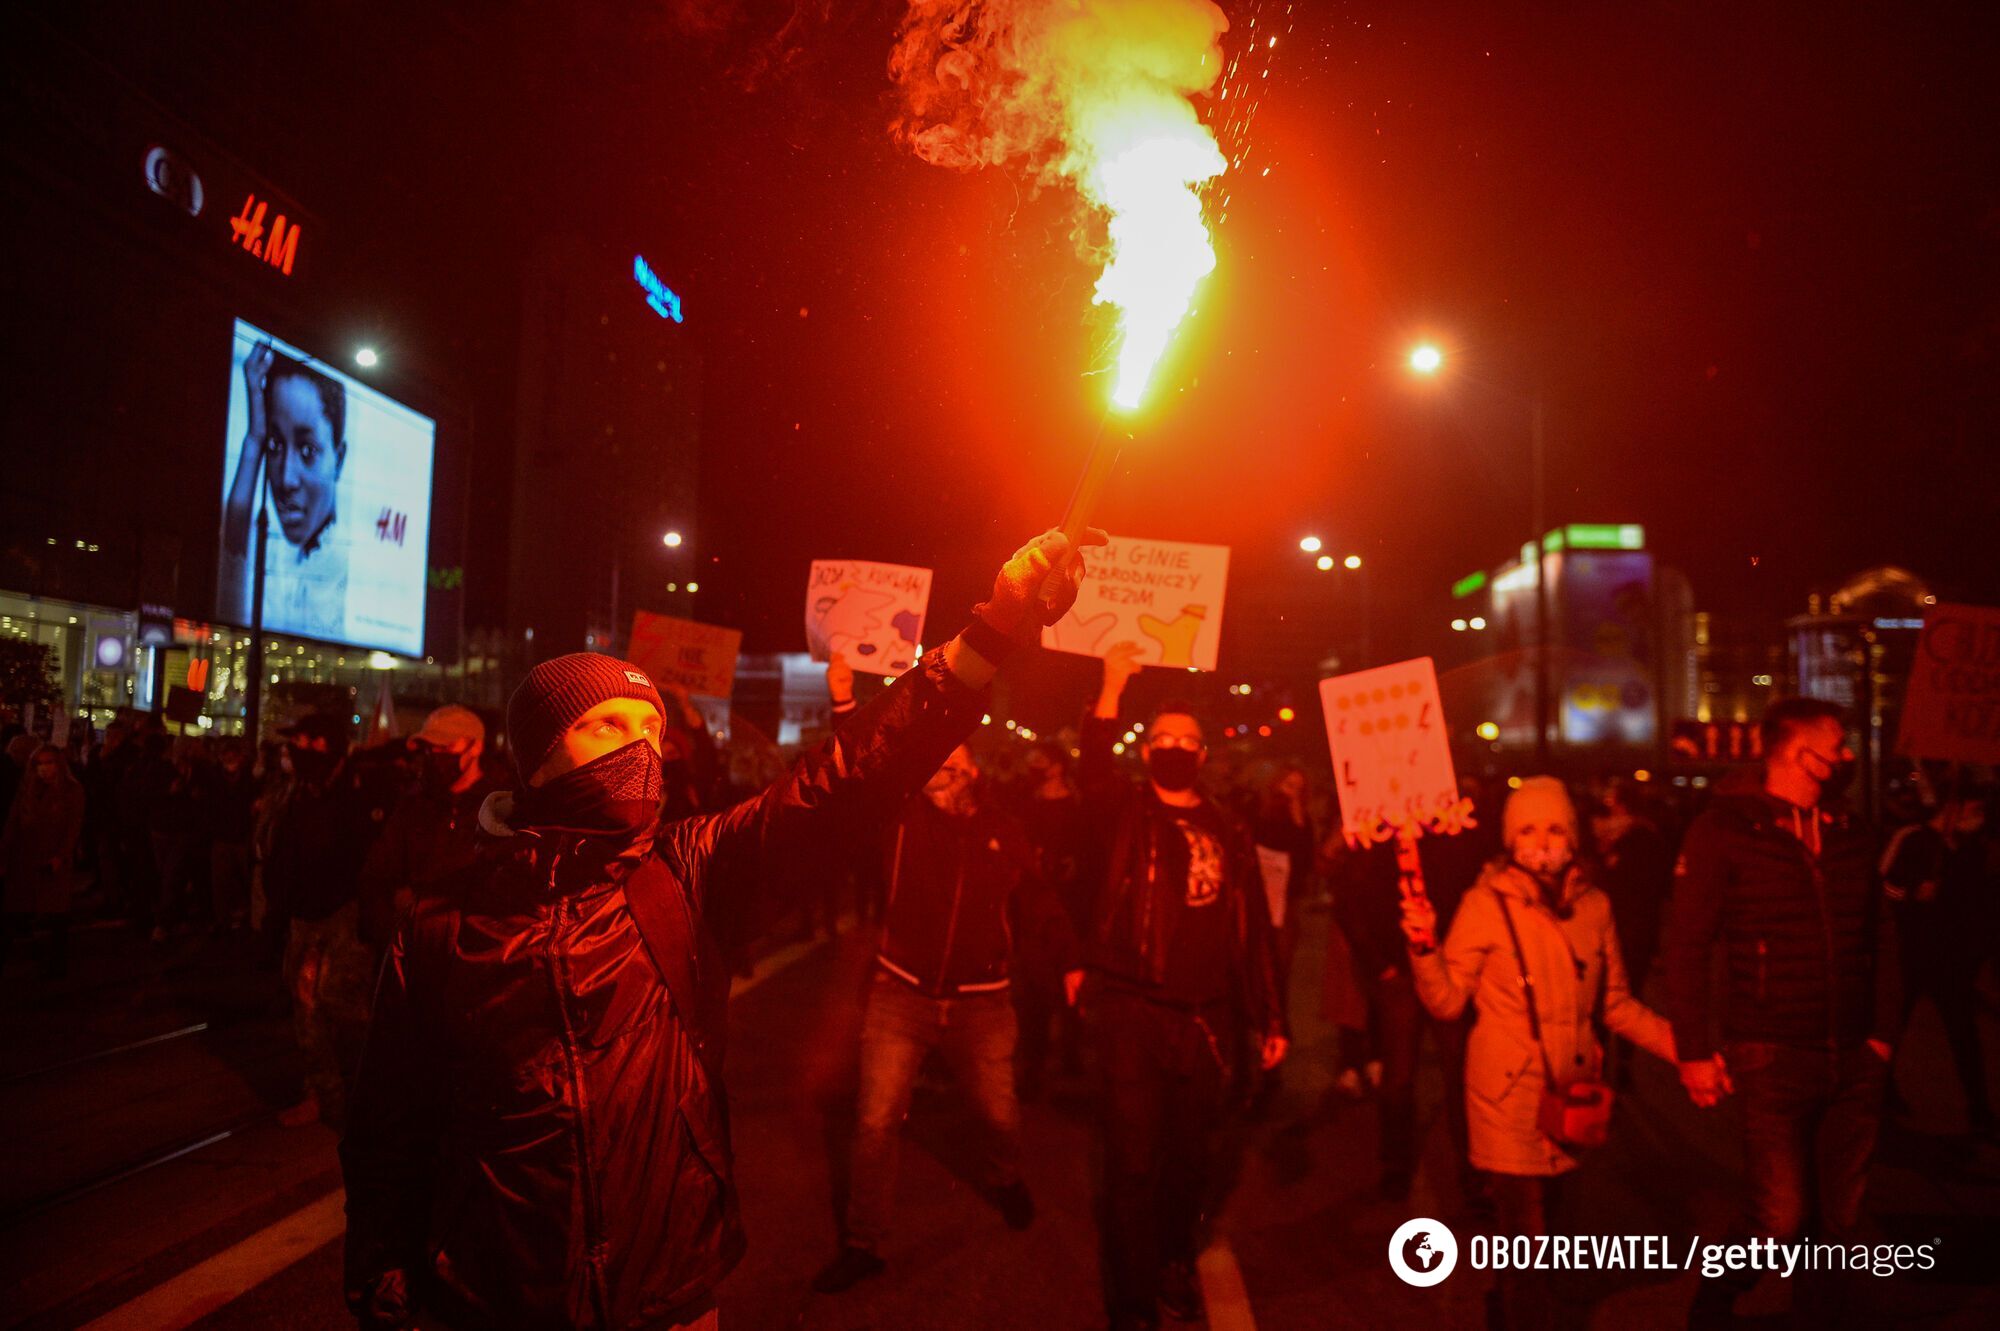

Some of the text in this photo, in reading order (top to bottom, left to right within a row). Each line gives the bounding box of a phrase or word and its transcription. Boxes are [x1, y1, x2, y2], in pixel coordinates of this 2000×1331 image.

[230, 193, 300, 276] H&M
[376, 506, 407, 547] H&M
[1128, 544, 1191, 570] GINIE
[1086, 564, 1201, 591] ZBRODNICZY
